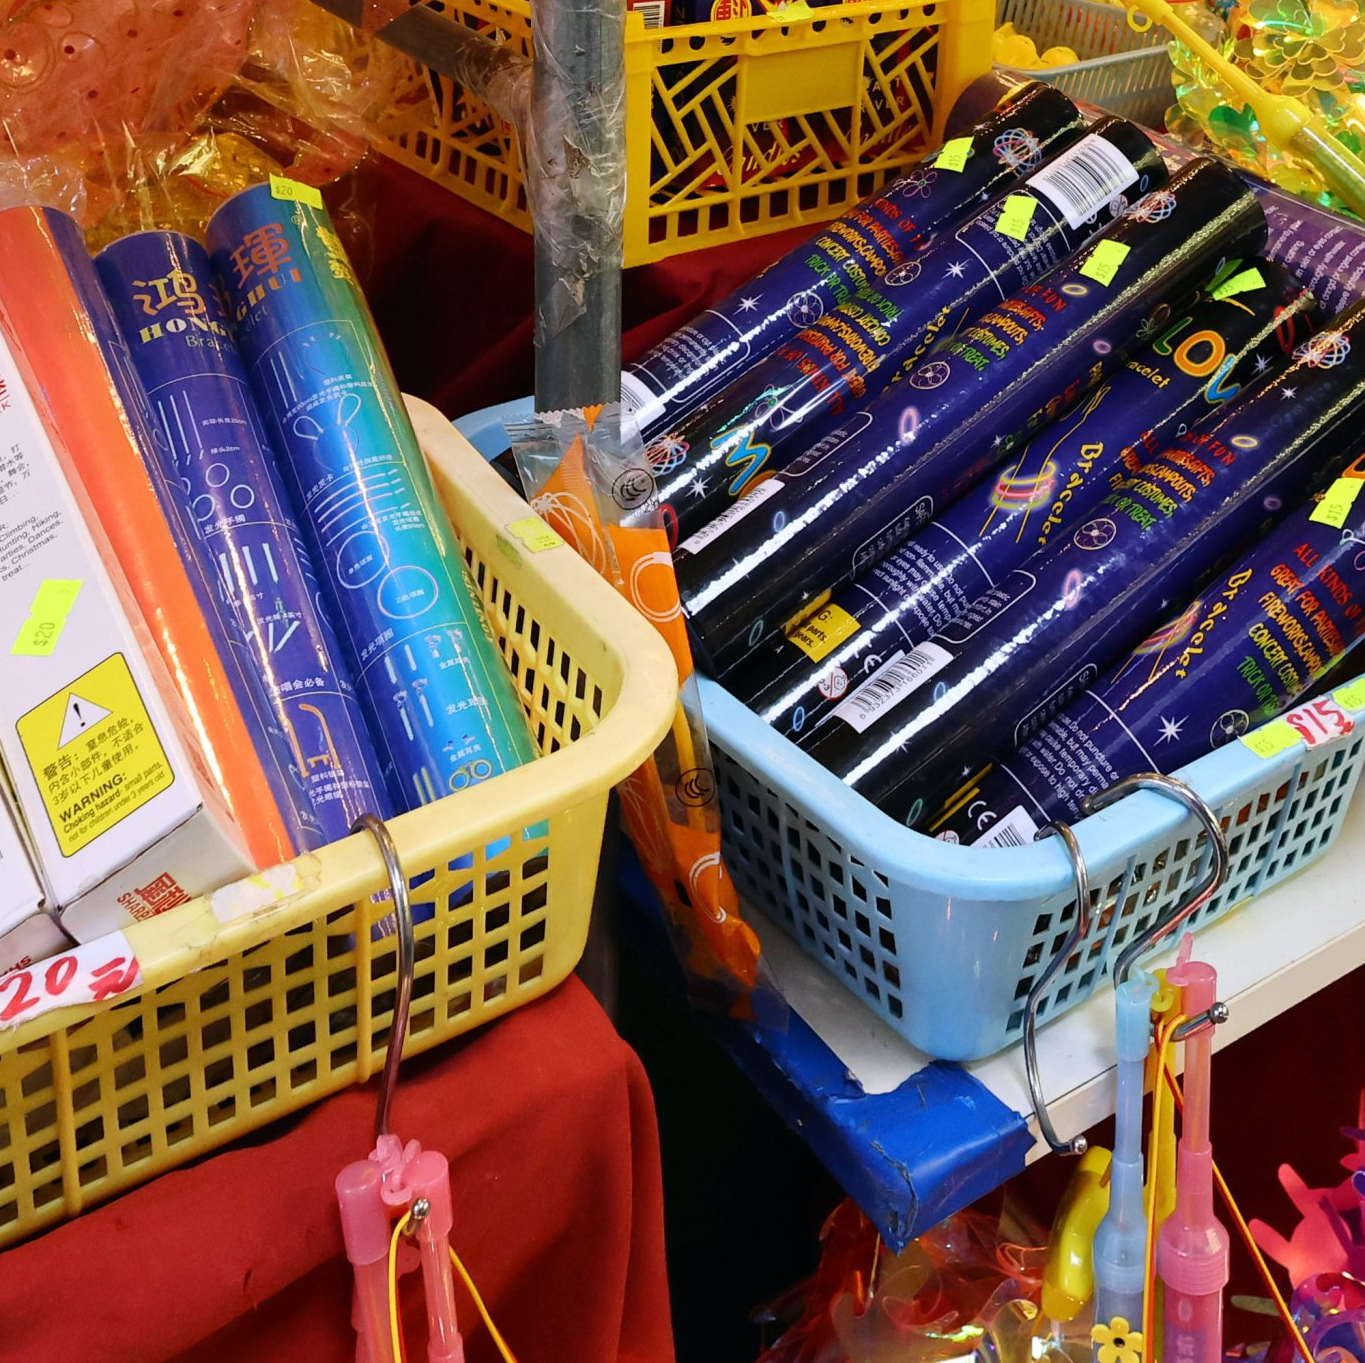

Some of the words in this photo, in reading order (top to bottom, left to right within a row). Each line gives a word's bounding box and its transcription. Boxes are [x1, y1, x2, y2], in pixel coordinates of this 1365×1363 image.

[276, 185, 292, 196] $20
[1270, 564, 1306, 596] GREAT
[1295, 590, 1320, 617] FOR
[1293, 543, 1320, 568] ALL
[1318, 563, 1354, 606] KINDS
[32, 621, 56, 647] $20
[1174, 568, 1254, 679] Bracelet
[1248, 623, 1288, 668] CONCERT
[1237, 656, 1263, 685] TRICK
[58, 772, 127, 823] WARNING:
